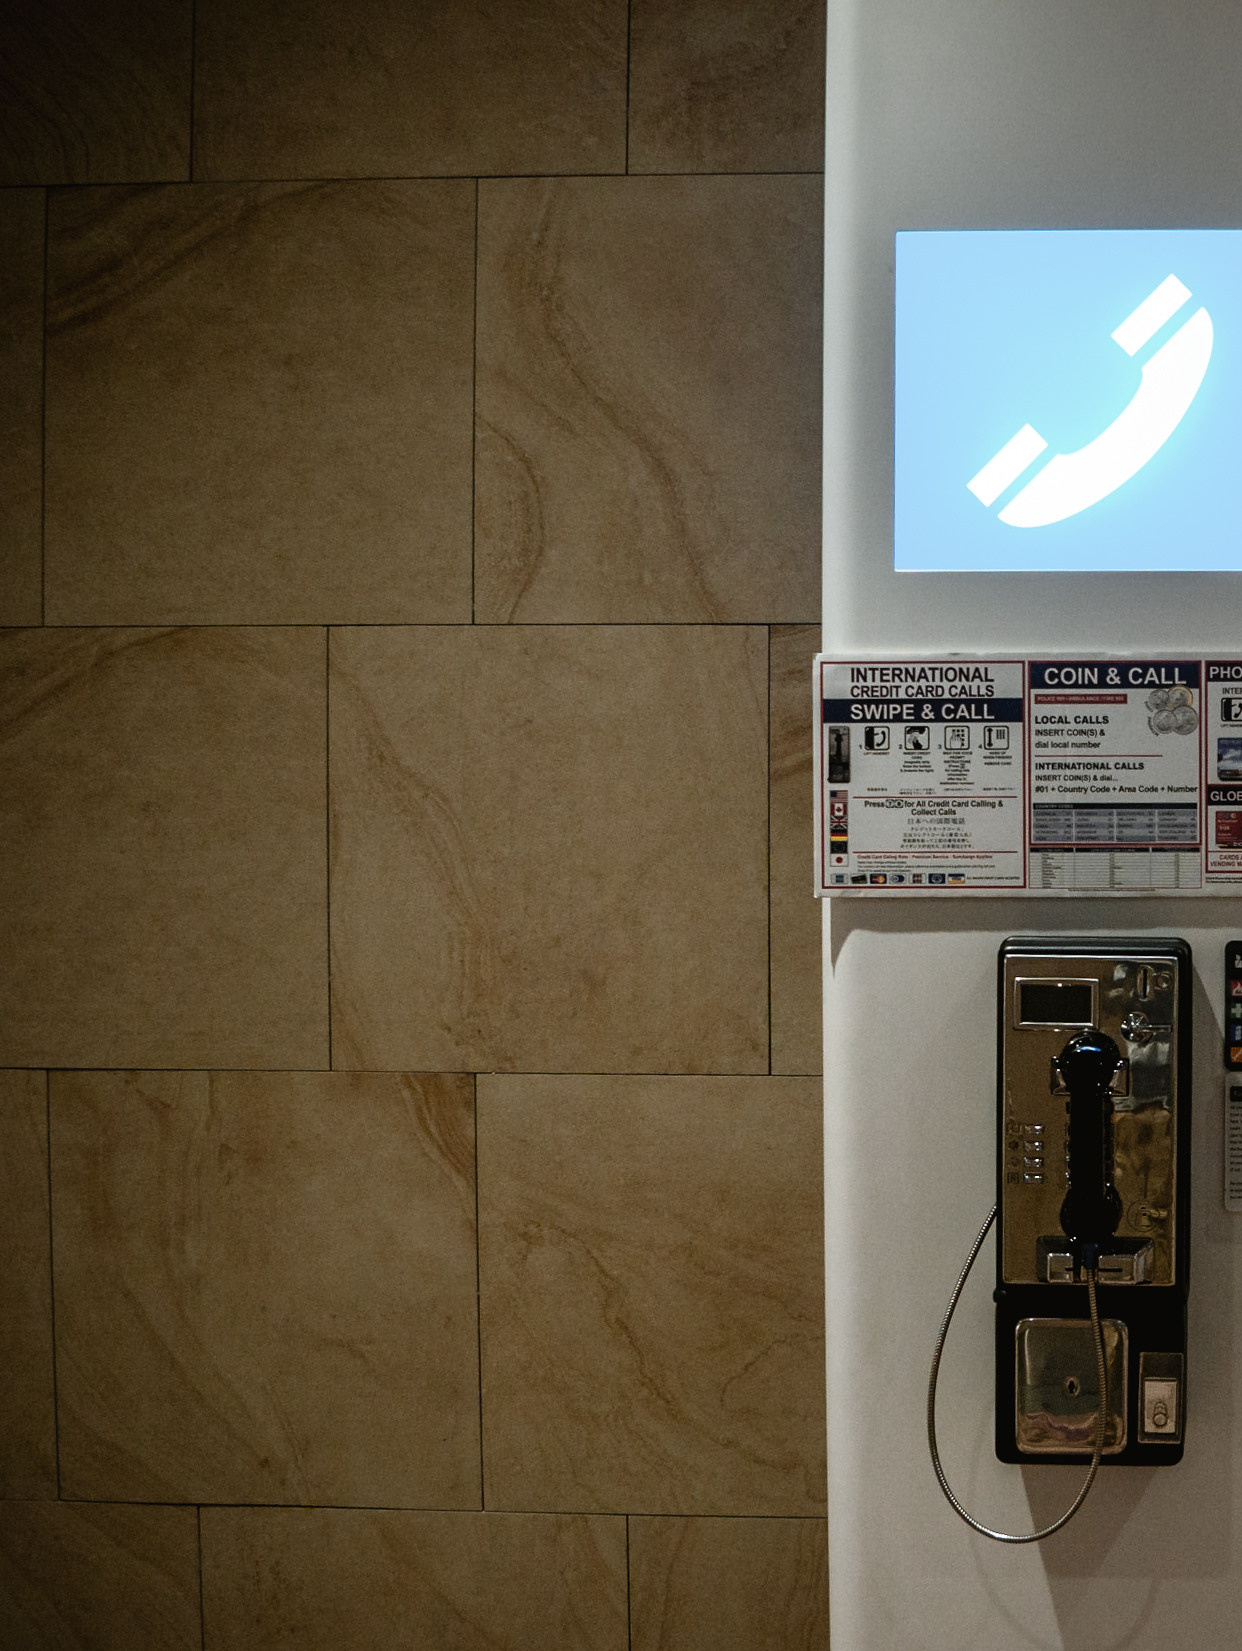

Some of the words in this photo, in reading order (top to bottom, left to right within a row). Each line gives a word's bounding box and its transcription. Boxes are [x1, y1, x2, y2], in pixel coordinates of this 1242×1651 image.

[851, 667, 994, 683] INTERNATIONAL
[1044, 667, 1098, 685] COIN
[1106, 667, 1121, 685] &
[1128, 667, 1187, 685] CALL
[850, 685, 901, 698] CREDIT
[904, 685, 944, 698] CARD
[948, 685, 994, 698] CALLS
[850, 704, 915, 720] SWIPE
[920, 704, 935, 720] &
[941, 704, 995, 720] CALL
[1035, 716, 1071, 724] LOCAL
[1074, 716, 1109, 724] CALLS
[1066, 729, 1098, 738] COIN(S)
[1057, 786, 1088, 794] Country
[970, 800, 996, 808] Calling
